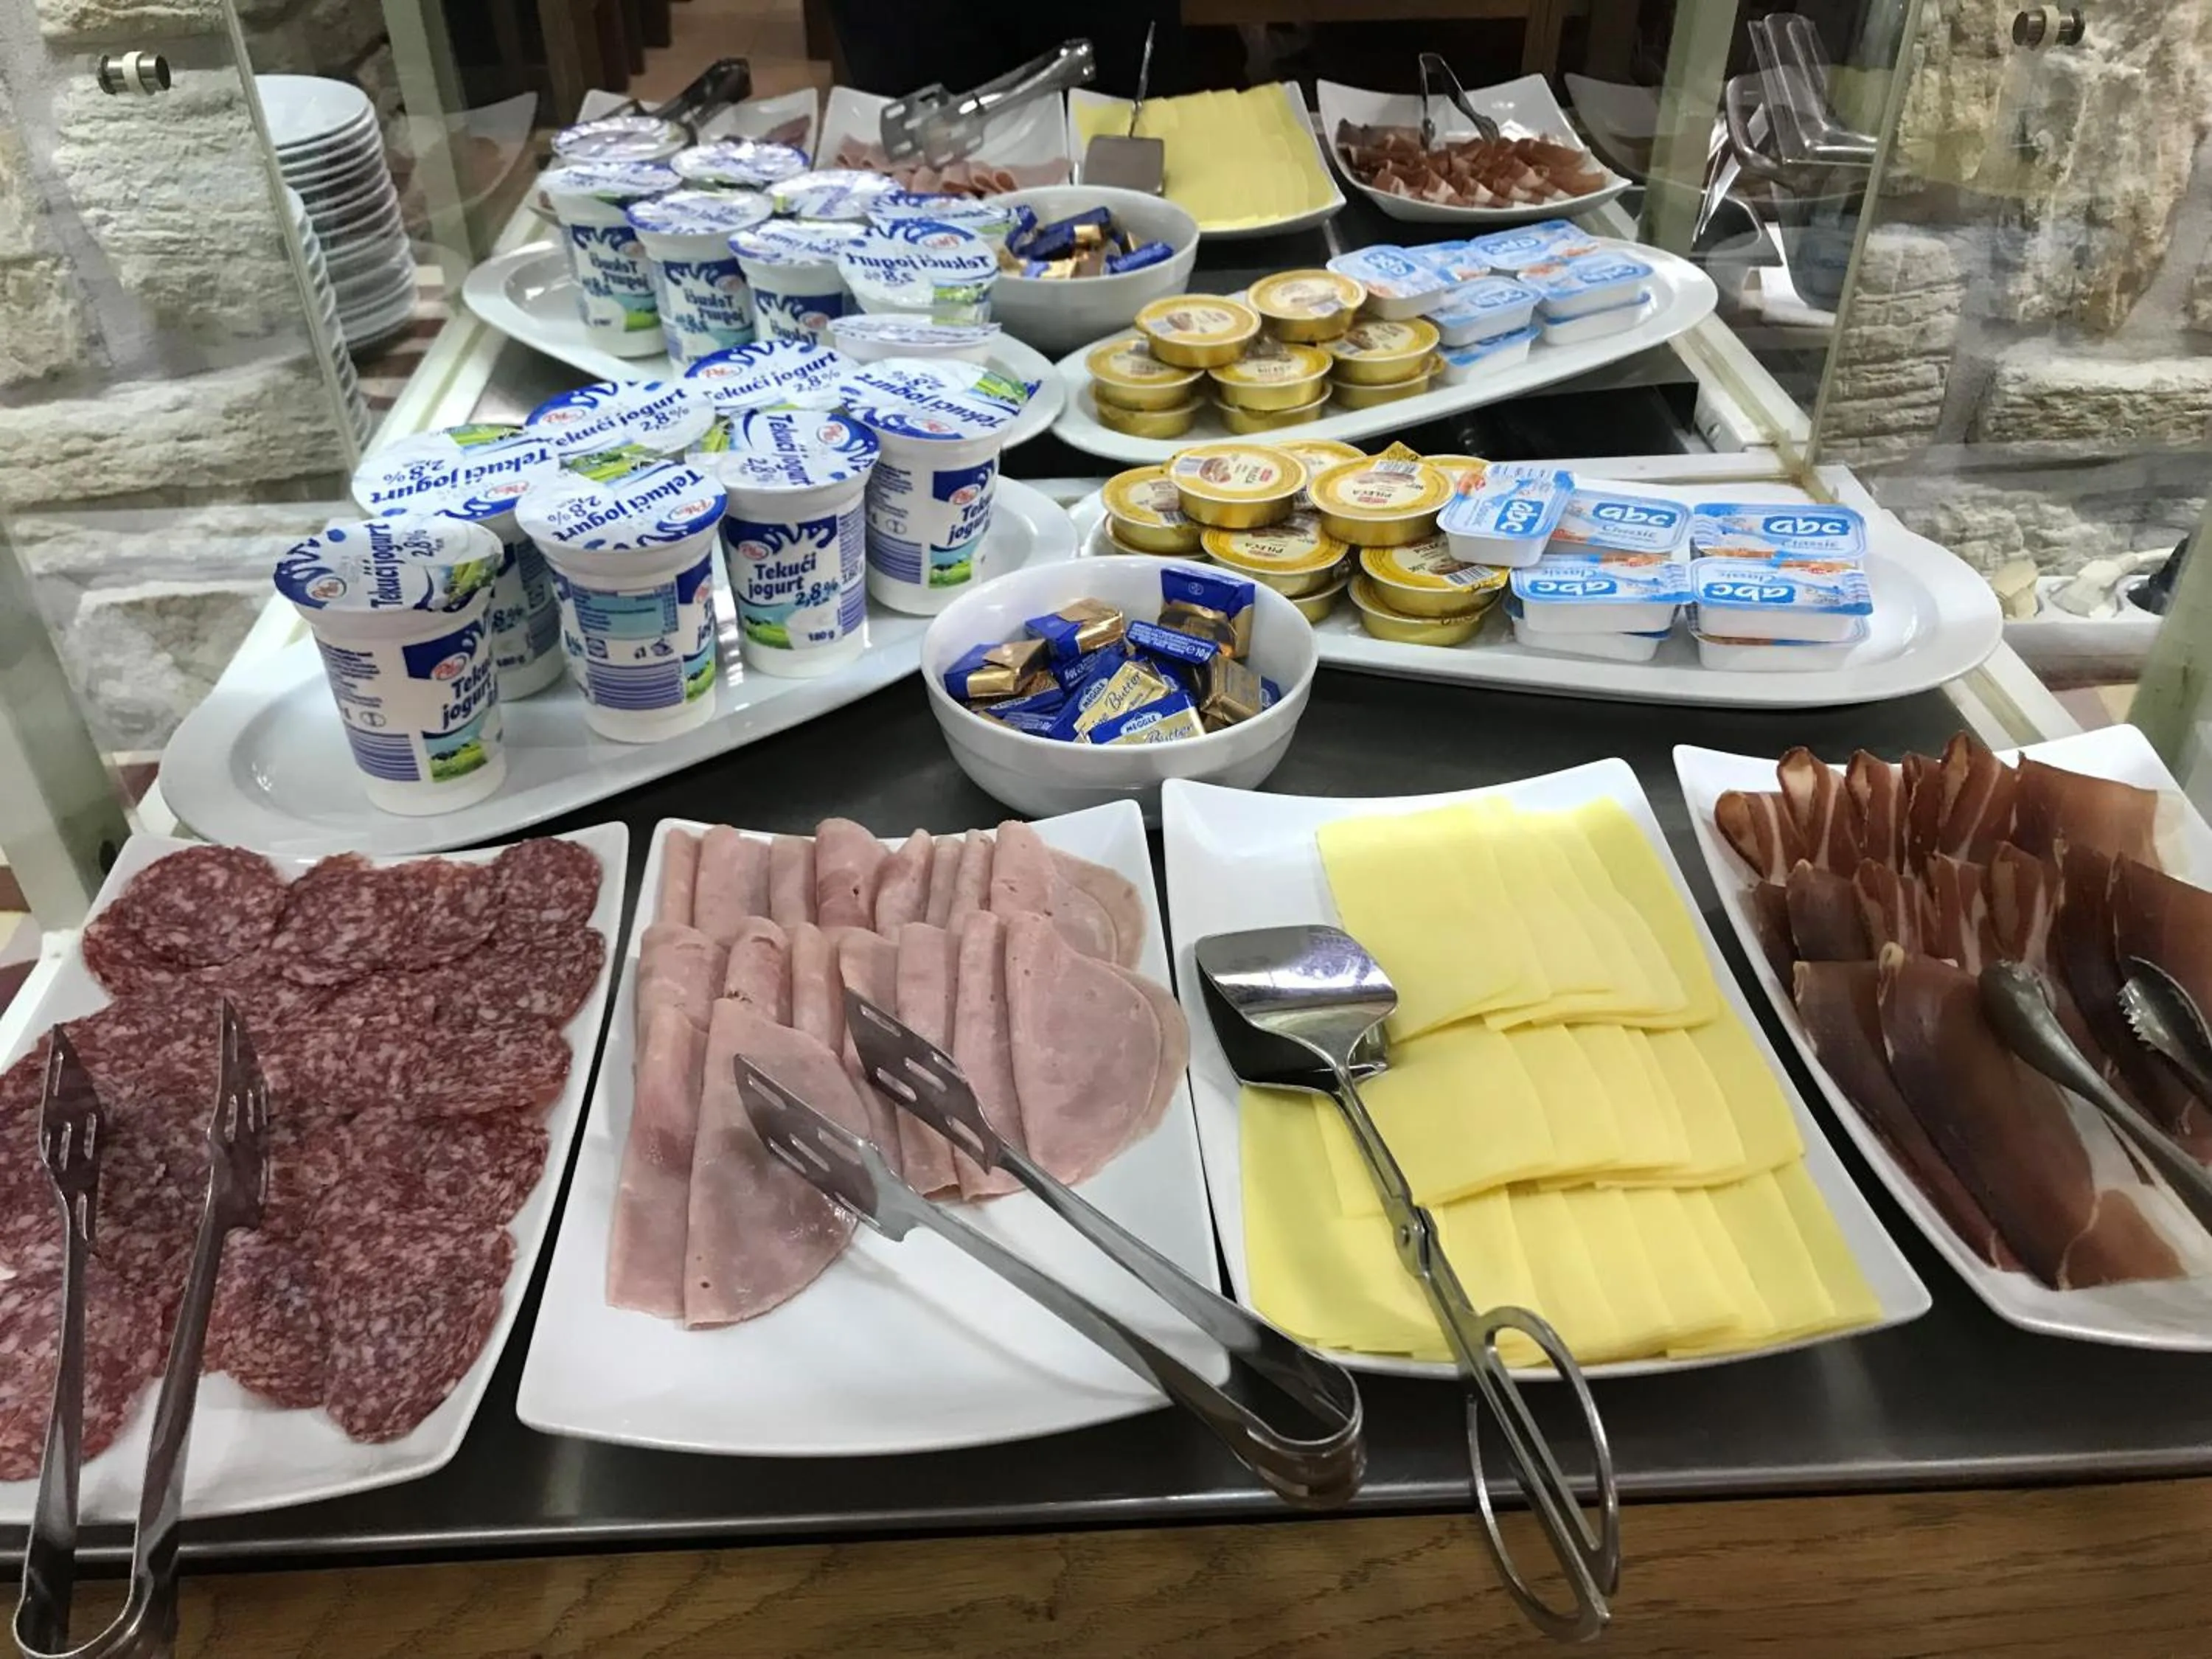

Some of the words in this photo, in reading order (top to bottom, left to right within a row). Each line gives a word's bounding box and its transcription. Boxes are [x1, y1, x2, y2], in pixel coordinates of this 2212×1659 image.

[771, 350, 839, 386] jogurt
[547, 415, 616, 447] ekući
[616, 388, 688, 426] jogurt
[465, 447, 553, 484] Tekući
[369, 467, 460, 504] jogurt
[627, 468, 706, 515] Tekući
[552, 499, 633, 543] jogurt
[1598, 506, 1671, 526] abc
[1769, 517, 1844, 535] abc
[754, 552, 817, 580] Tekući
[748, 576, 804, 600] jogurt
[1537, 580, 1610, 597] abc
[1709, 583, 1790, 602] abc
[1106, 672, 1144, 712] Butter
[1125, 714, 1158, 733] MEGGLE
